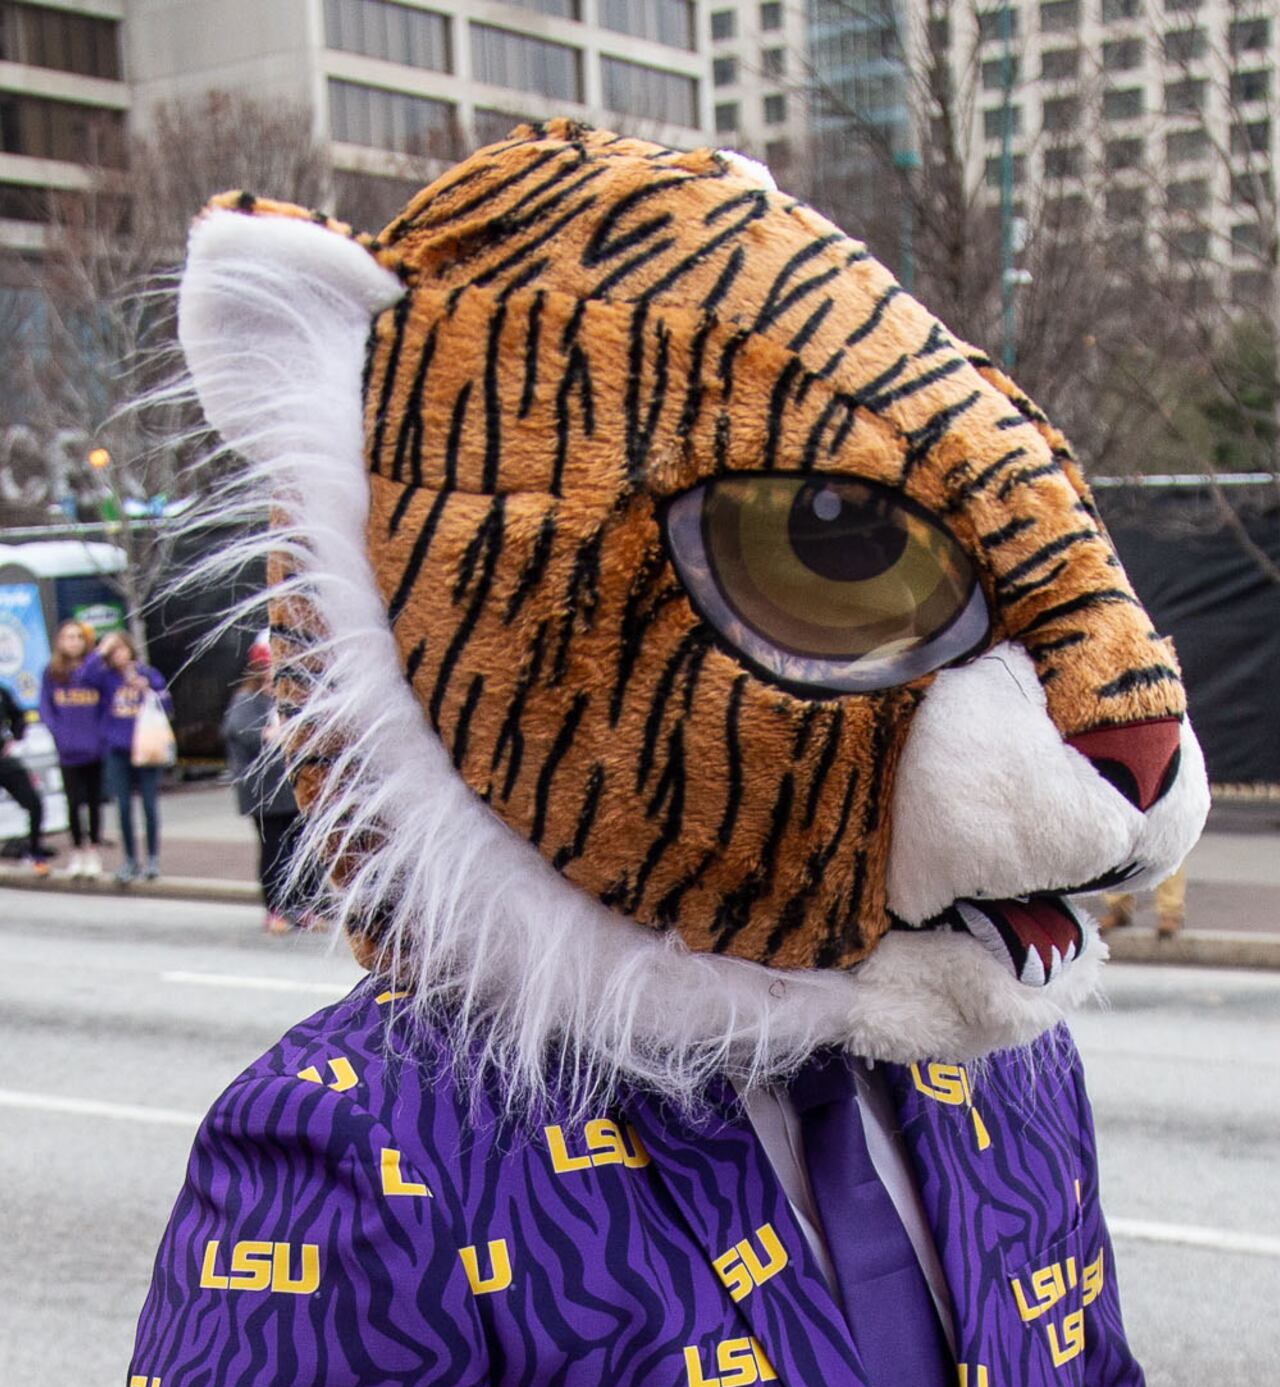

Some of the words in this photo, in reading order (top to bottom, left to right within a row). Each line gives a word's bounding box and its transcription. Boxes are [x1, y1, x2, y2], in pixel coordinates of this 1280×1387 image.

[544, 1118, 650, 1173] LSU
[200, 1240, 320, 1294] LSU
[712, 1223, 788, 1302] SU
[1046, 1308, 1086, 1368] LS
